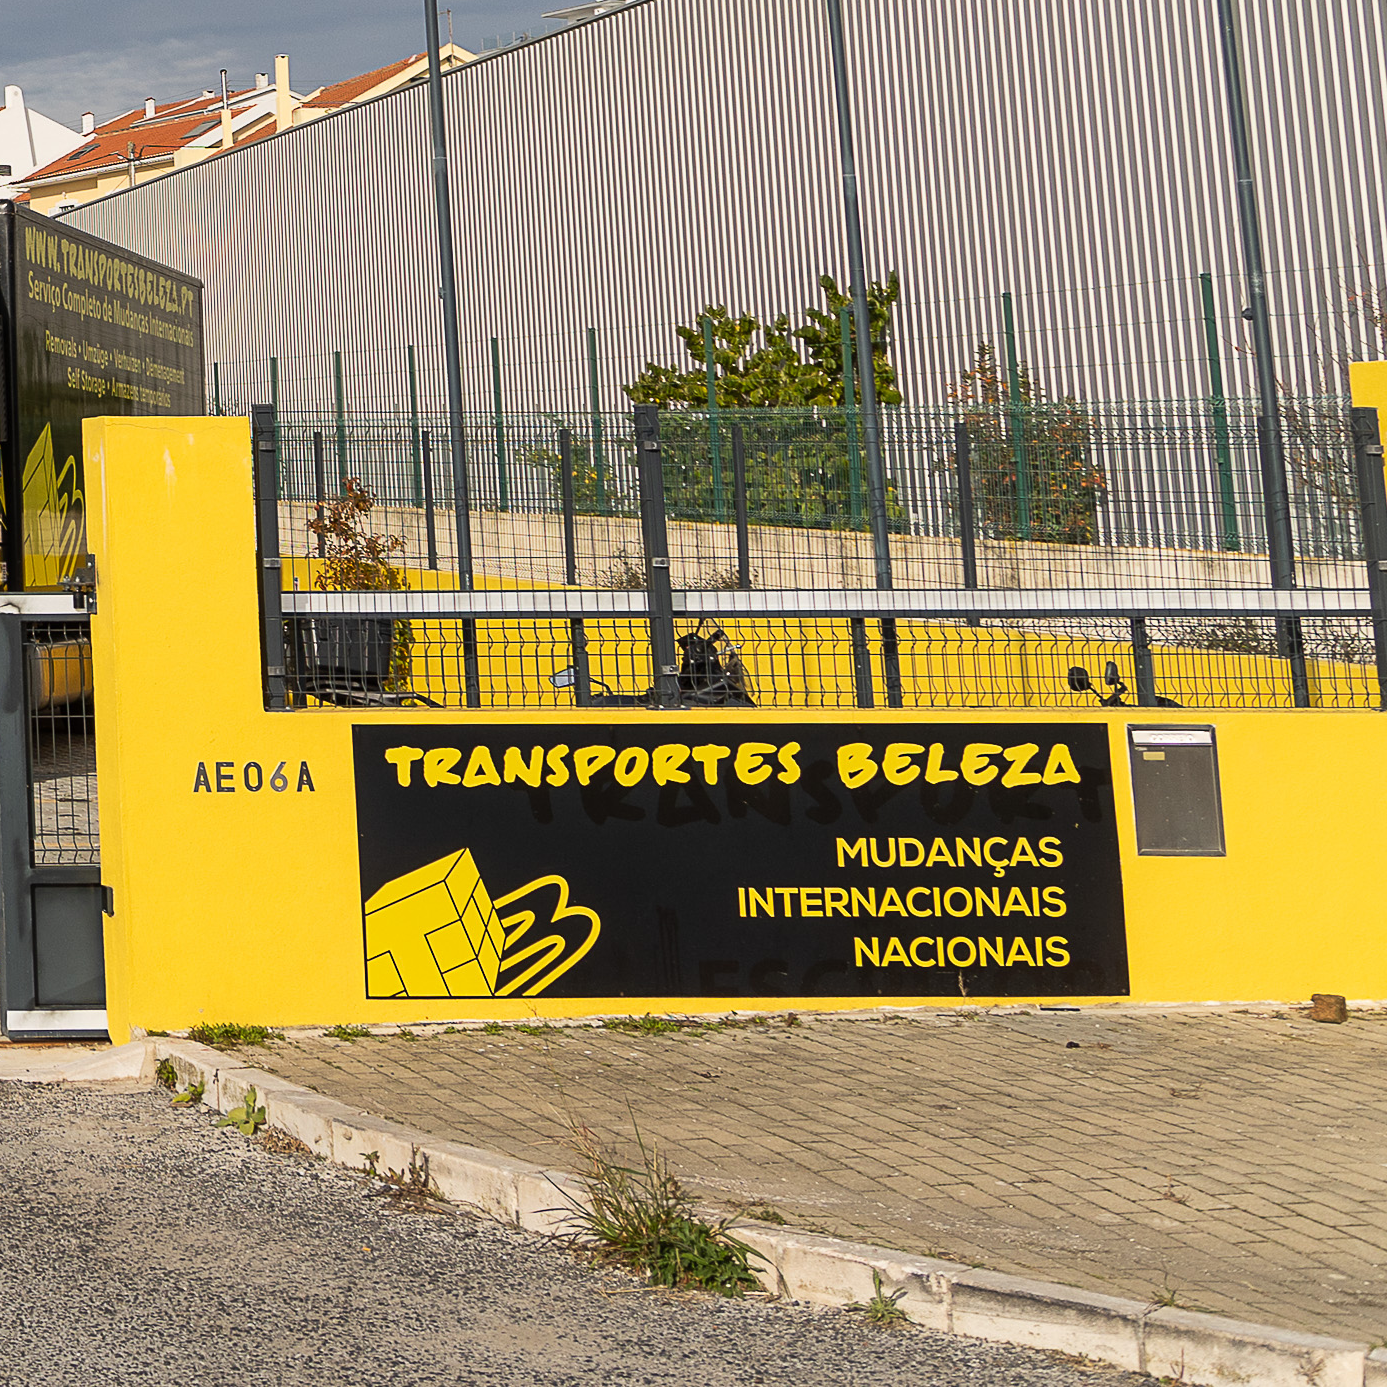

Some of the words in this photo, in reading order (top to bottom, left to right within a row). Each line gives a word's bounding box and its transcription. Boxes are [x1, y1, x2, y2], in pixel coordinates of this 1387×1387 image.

[25, 226, 194, 318] WWW.TRANSPORTESBELEZA.PT
[28, 270, 61, 313] Serviço
[61, 282, 102, 322] Completo
[102, 294, 113, 323] de
[113, 299, 149, 338] Mudanças
[149, 311, 194, 348] Internacionais
[45, 329, 77, 359] Removals
[81, 369, 106, 399] Storage
[384, 741, 803, 788] TRANSPORTES
[837, 742, 1082, 789] BELEZA
[836, 836, 1064, 877] MUDANÇAS
[737, 886, 1067, 919] INTERNACIONAIS
[853, 935, 1072, 968] NACIONAIS
